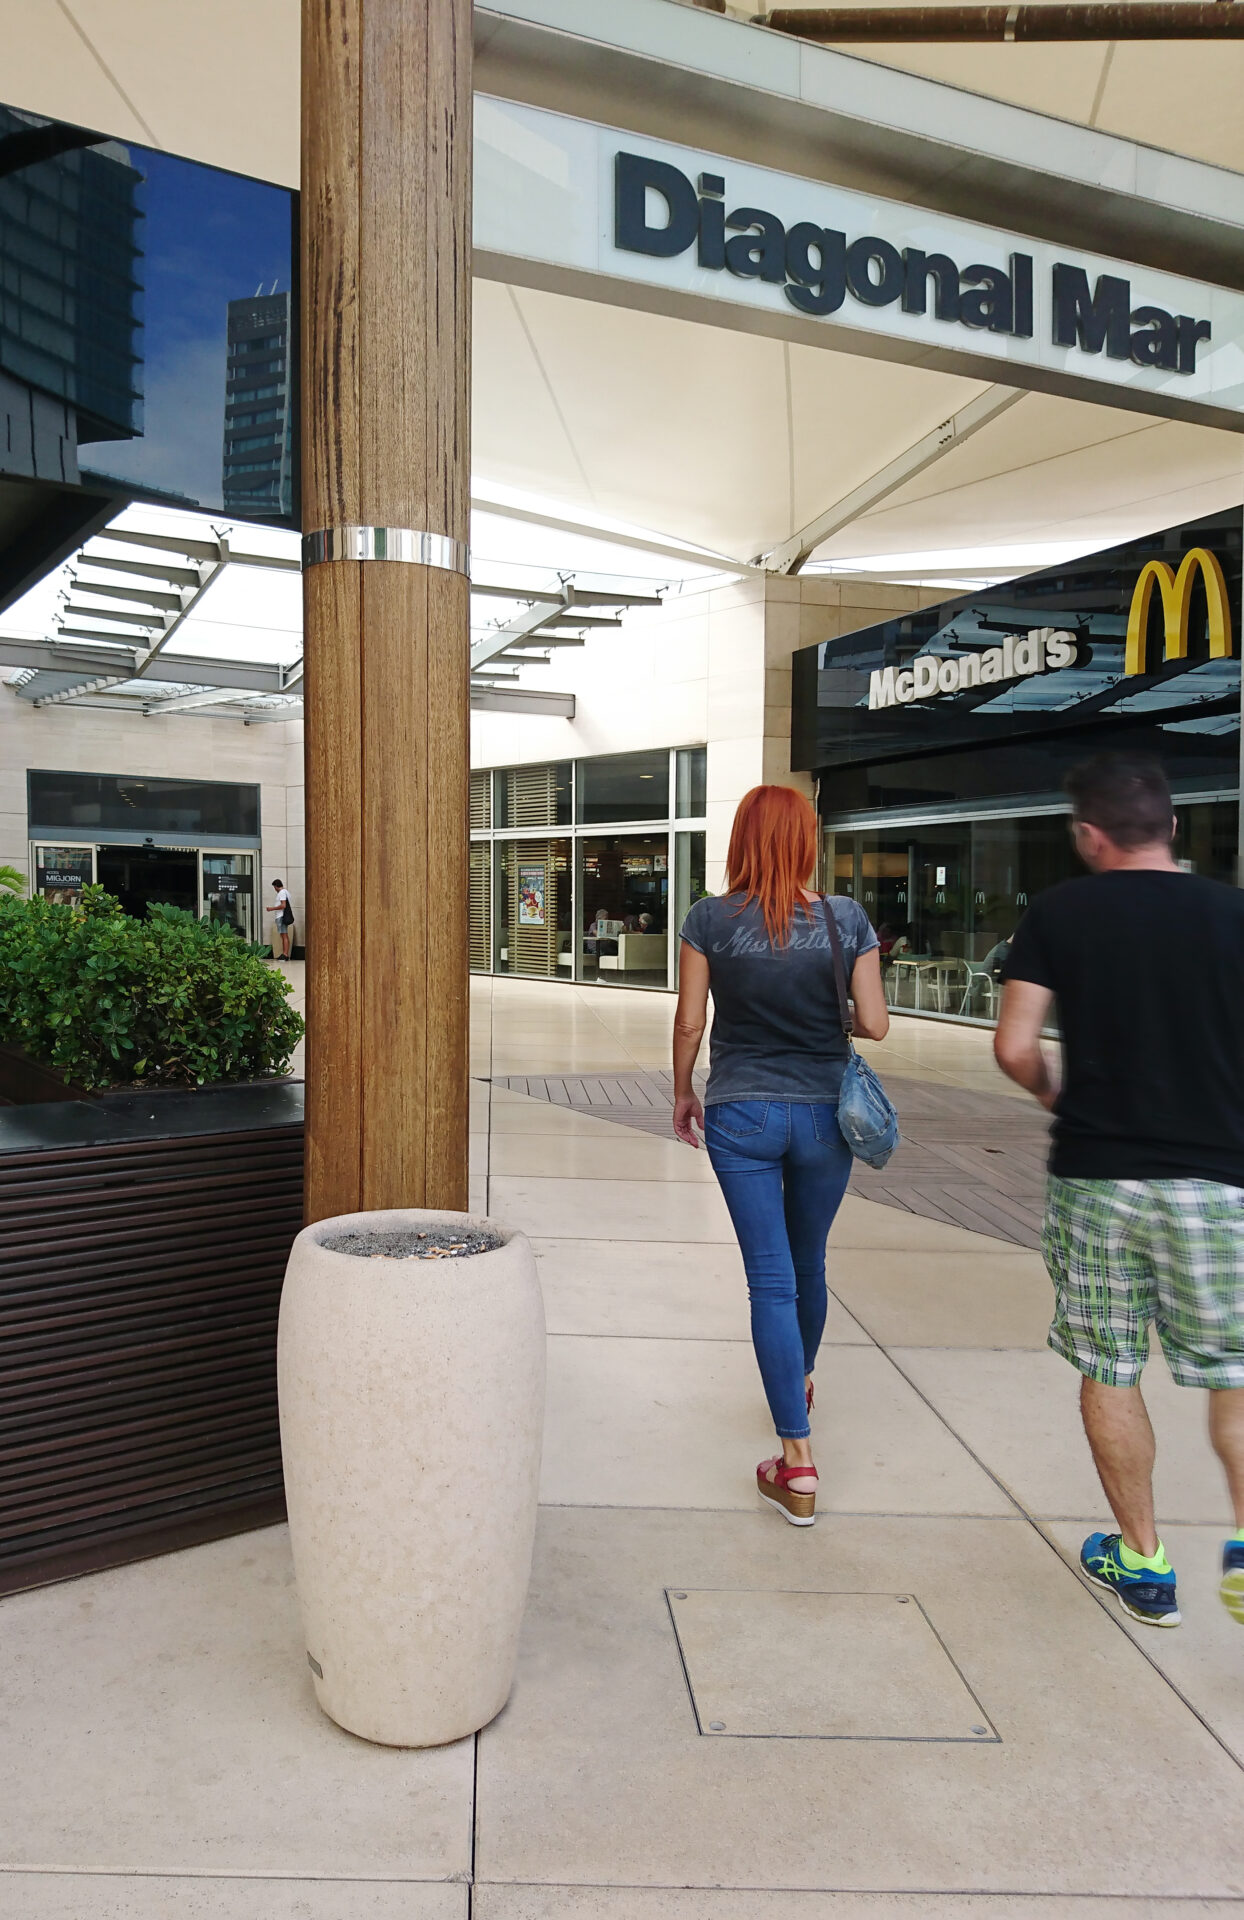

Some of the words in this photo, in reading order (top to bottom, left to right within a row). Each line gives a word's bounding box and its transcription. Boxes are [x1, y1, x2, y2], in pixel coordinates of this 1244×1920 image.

[614, 151, 1034, 338] Diagonal
[1052, 262, 1212, 375] Mar
[868, 627, 1078, 711] McDonald's
[45, 874, 82, 882] MIGJORN
[712, 926, 769, 958] Miss
